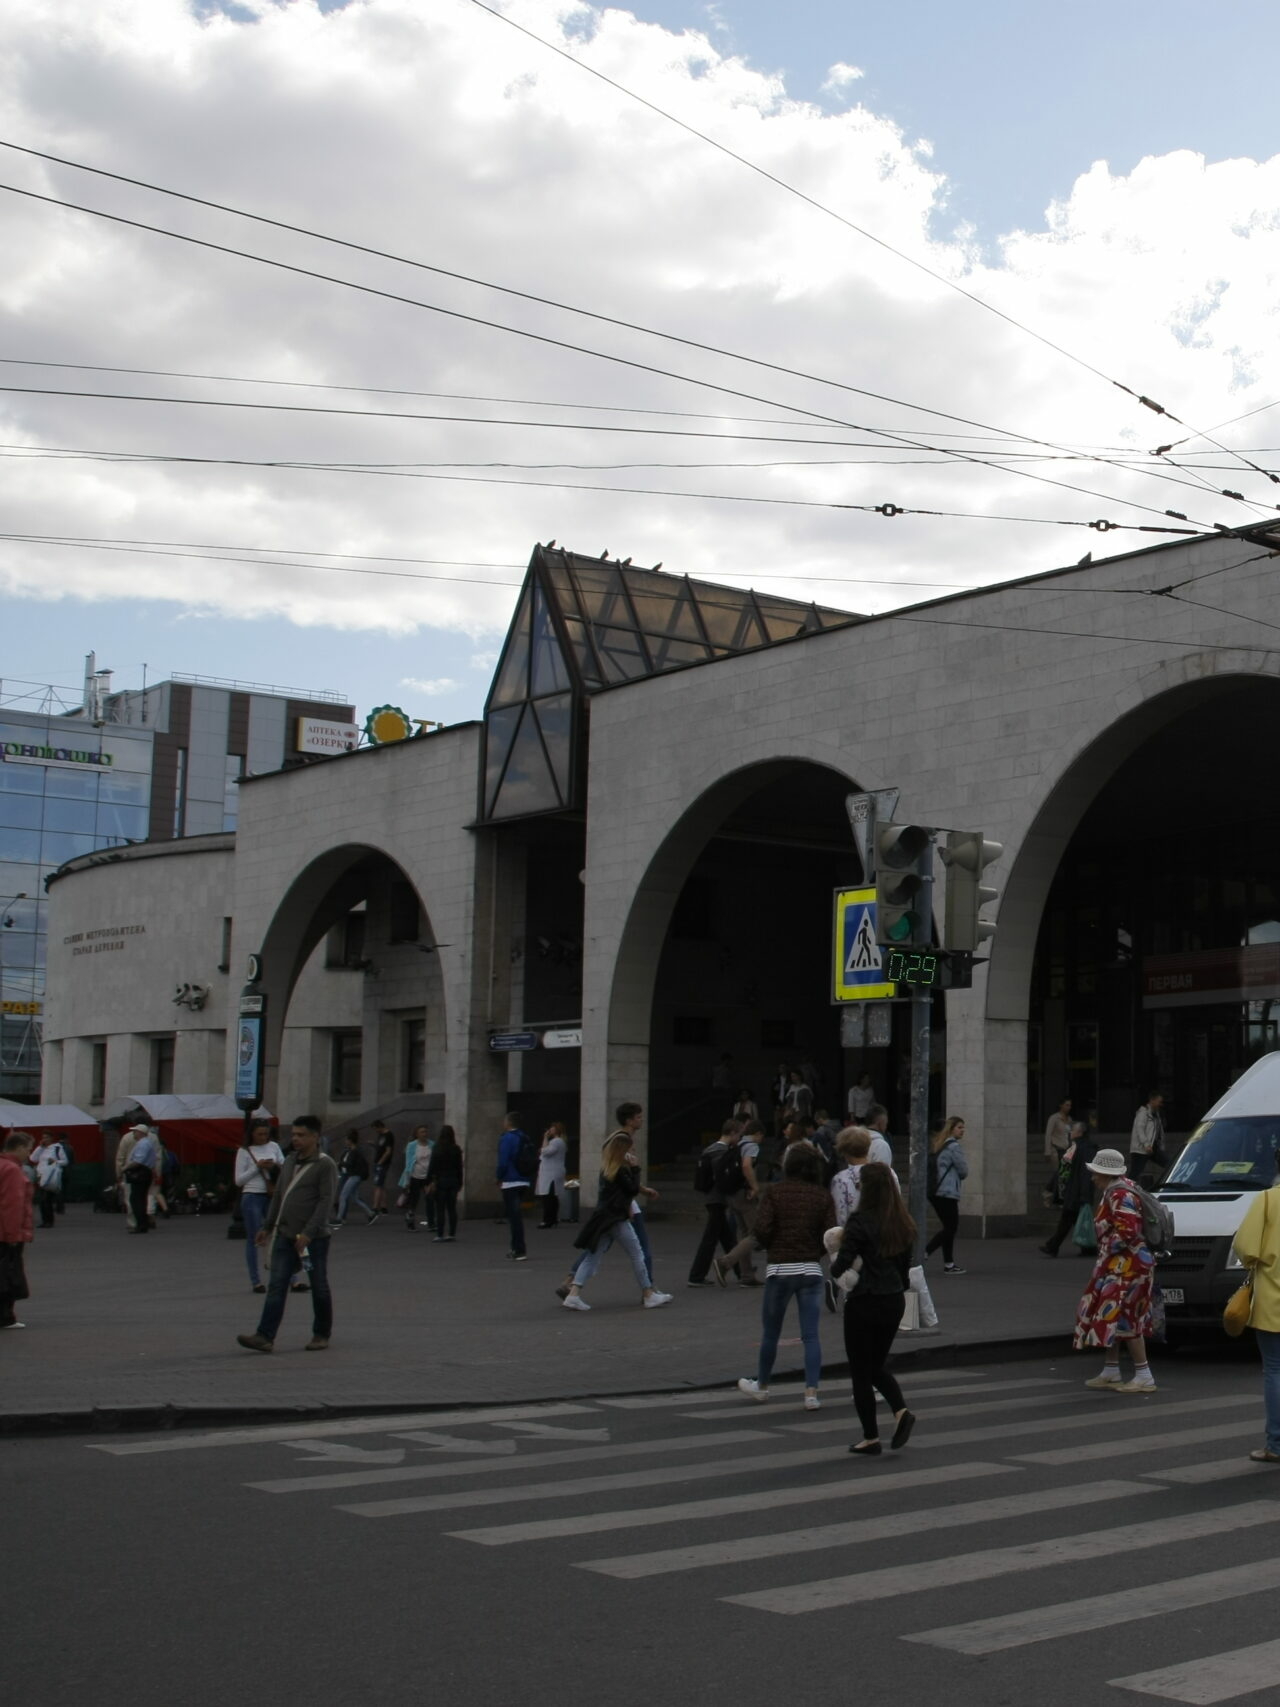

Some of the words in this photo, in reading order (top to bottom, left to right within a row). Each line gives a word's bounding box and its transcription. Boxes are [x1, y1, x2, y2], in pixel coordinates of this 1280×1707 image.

[307, 725, 342, 737] АПТЕКА
[888, 953, 936, 984] 0:29
[1148, 974, 1193, 991] ПЕРВАЯ
